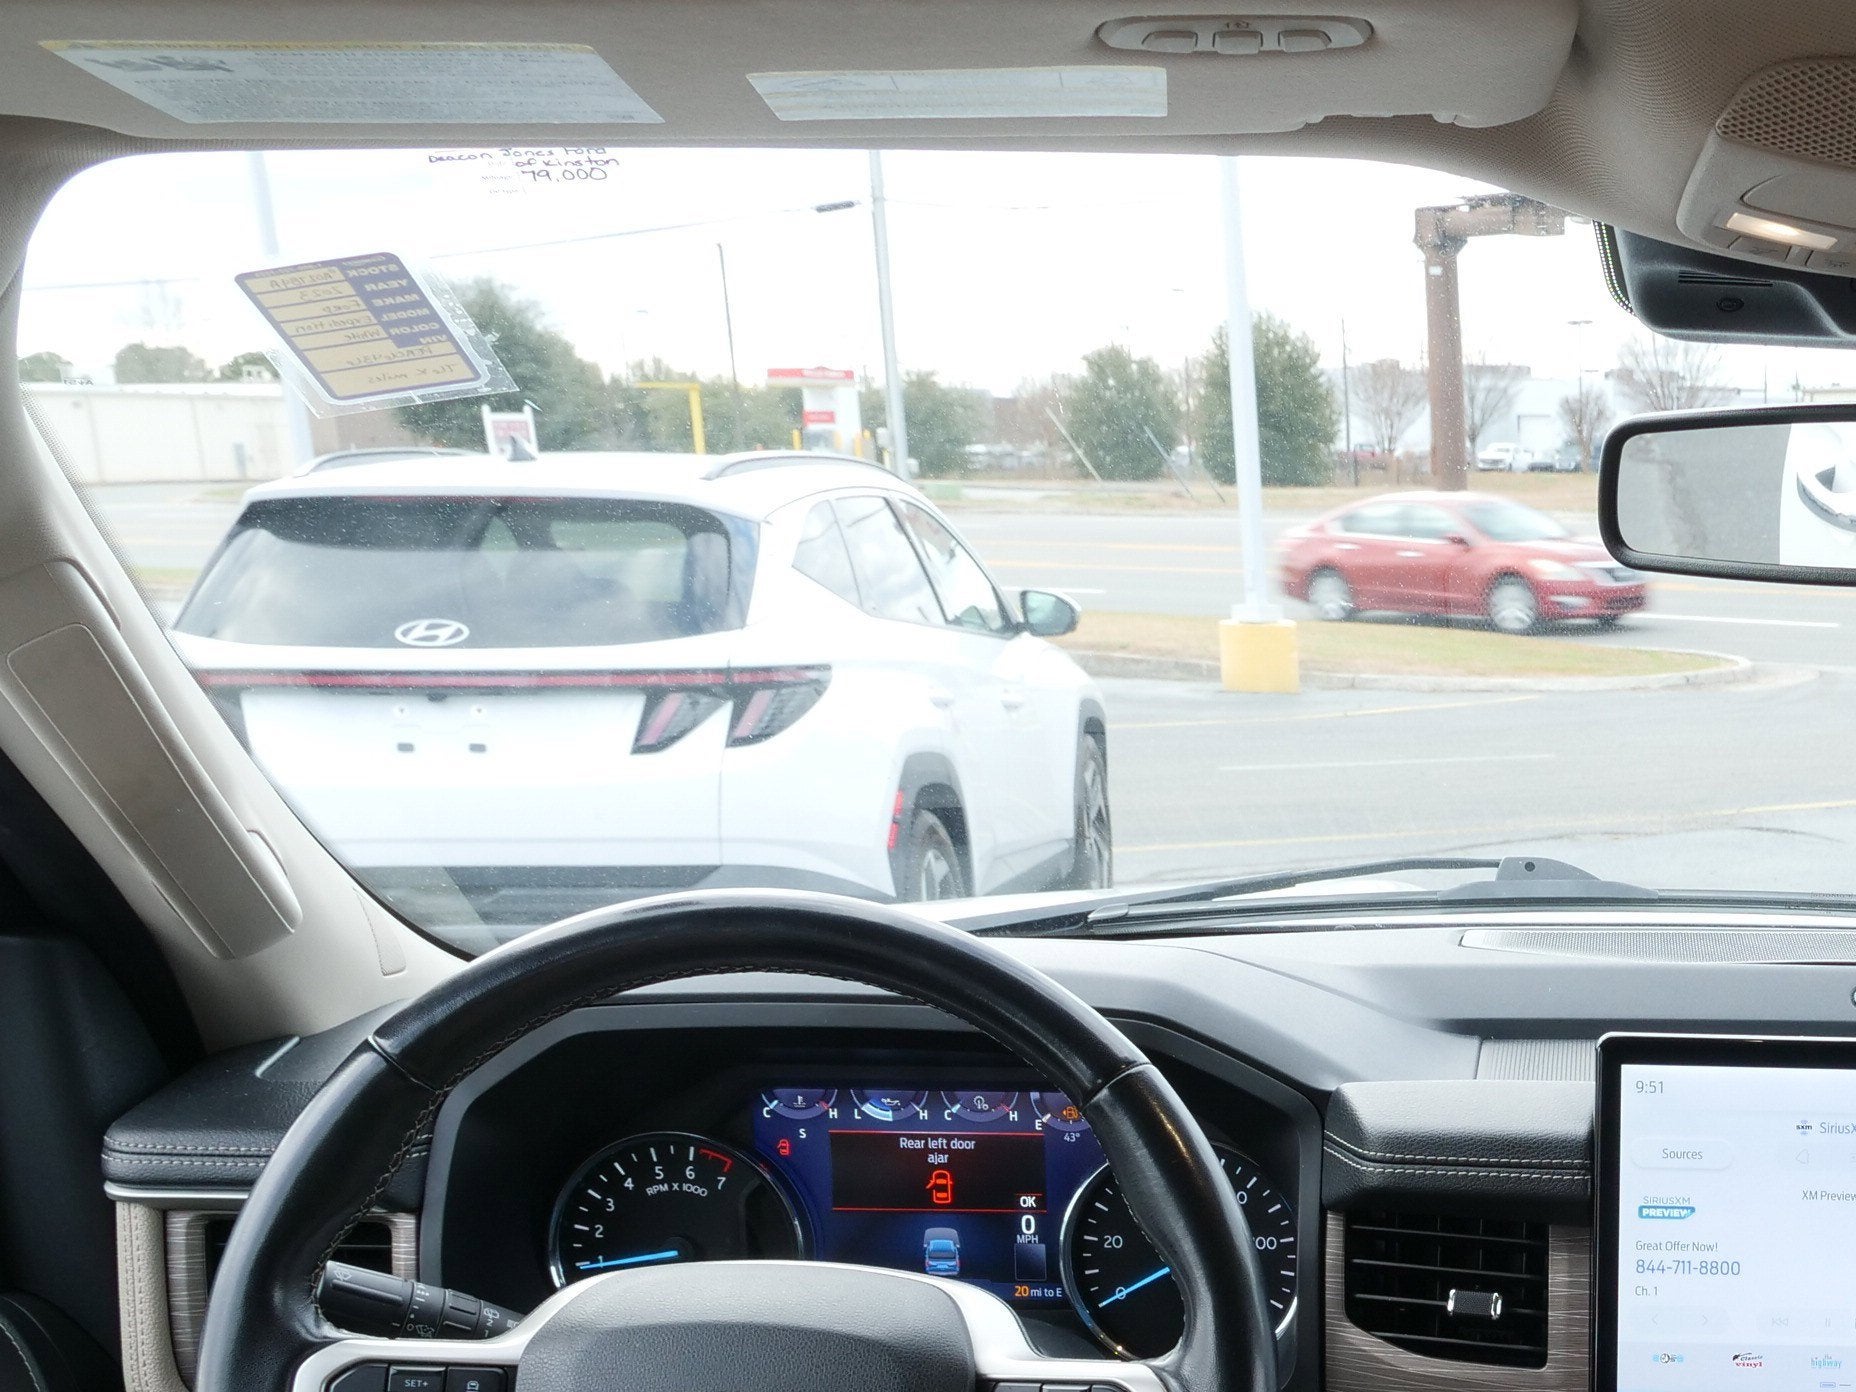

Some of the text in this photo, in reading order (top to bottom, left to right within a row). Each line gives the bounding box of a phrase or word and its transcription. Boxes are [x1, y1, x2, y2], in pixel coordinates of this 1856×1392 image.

[1635, 1080, 1664, 1095] 9:51
[829, 1108, 838, 1119] H
[919, 1110, 928, 1120] H
[1009, 1111, 1018, 1121] H
[1035, 1119, 1042, 1130] E
[900, 1137, 976, 1149] Rear left door
[1063, 1132, 1081, 1142] 43°
[927, 1152, 949, 1164] ajar
[1662, 1148, 1703, 1161] Sources
[655, 1166, 664, 1179] 5
[685, 1166, 695, 1179] 6
[624, 1177, 634, 1190] 4
[717, 1177, 726, 1190] 7
[646, 1182, 669, 1197] RPM
[682, 1184, 708, 1198] 1000
[1801, 1190, 1819, 1201] XM
[606, 1198, 615, 1211] 3
[1019, 1196, 1037, 1208] OK
[1643, 1196, 1691, 1206] SIRIUSXM
[1641, 1207, 1692, 1218] PREVIEW
[594, 1224, 604, 1237] 2
[1020, 1214, 1036, 1235] 0
[1016, 1234, 1039, 1244] MPH
[1103, 1235, 1123, 1249] 20
[1635, 1240, 1718, 1253] Great Offer Now!
[1635, 1259, 1741, 1276] 844-711-8800
[1014, 1285, 1062, 1297] 20 mi to E
[1635, 1285, 1651, 1297] Ch.
[1810, 1357, 1843, 1369] highway
[404, 1379, 429, 1388] SET+
